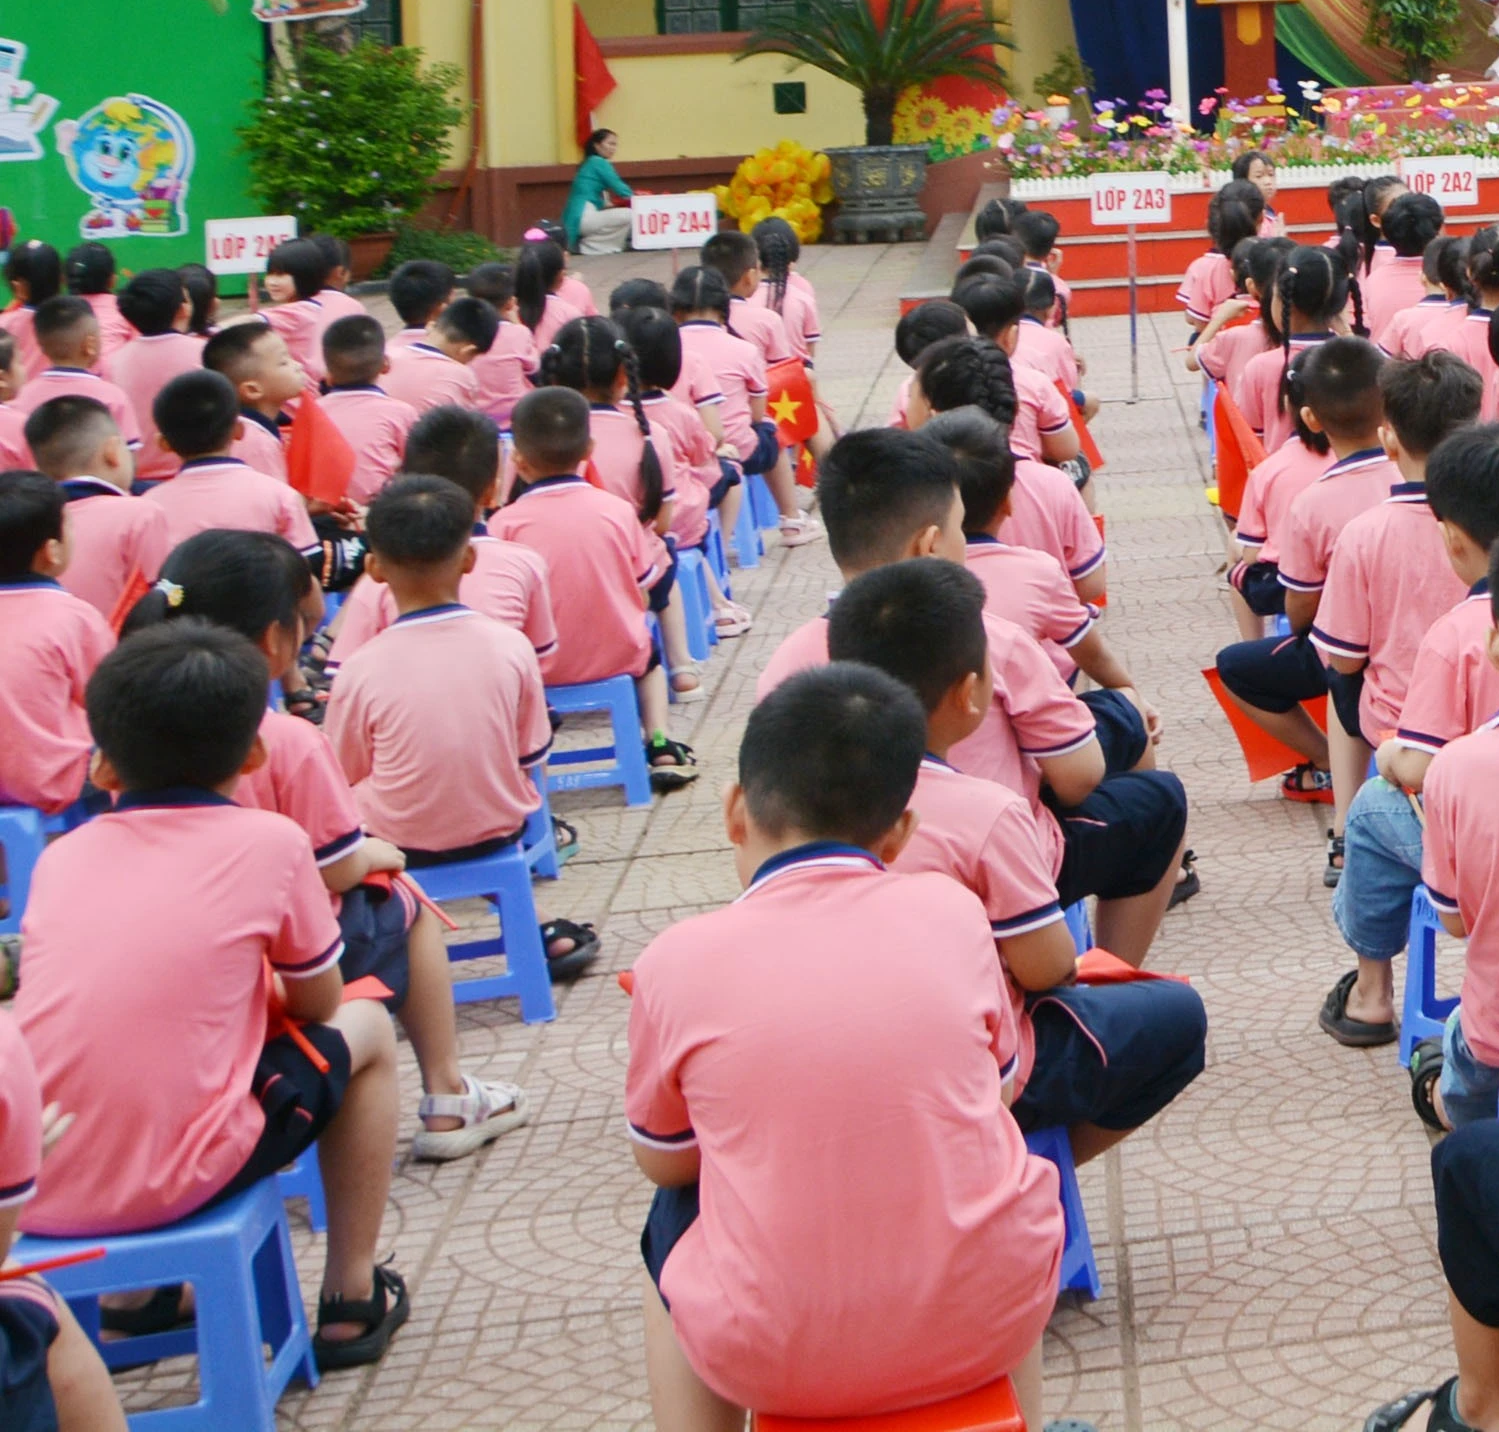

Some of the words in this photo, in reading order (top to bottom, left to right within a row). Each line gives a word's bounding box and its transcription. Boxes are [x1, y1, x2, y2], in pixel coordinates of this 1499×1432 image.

[1442, 171, 1472, 192] 2A2
[1096, 184, 1126, 211] LỚP
[1133, 188, 1165, 210] 2A3
[639, 209, 670, 236] LỚP
[679, 210, 711, 233] 2A4
[212, 233, 246, 260] LỚP
